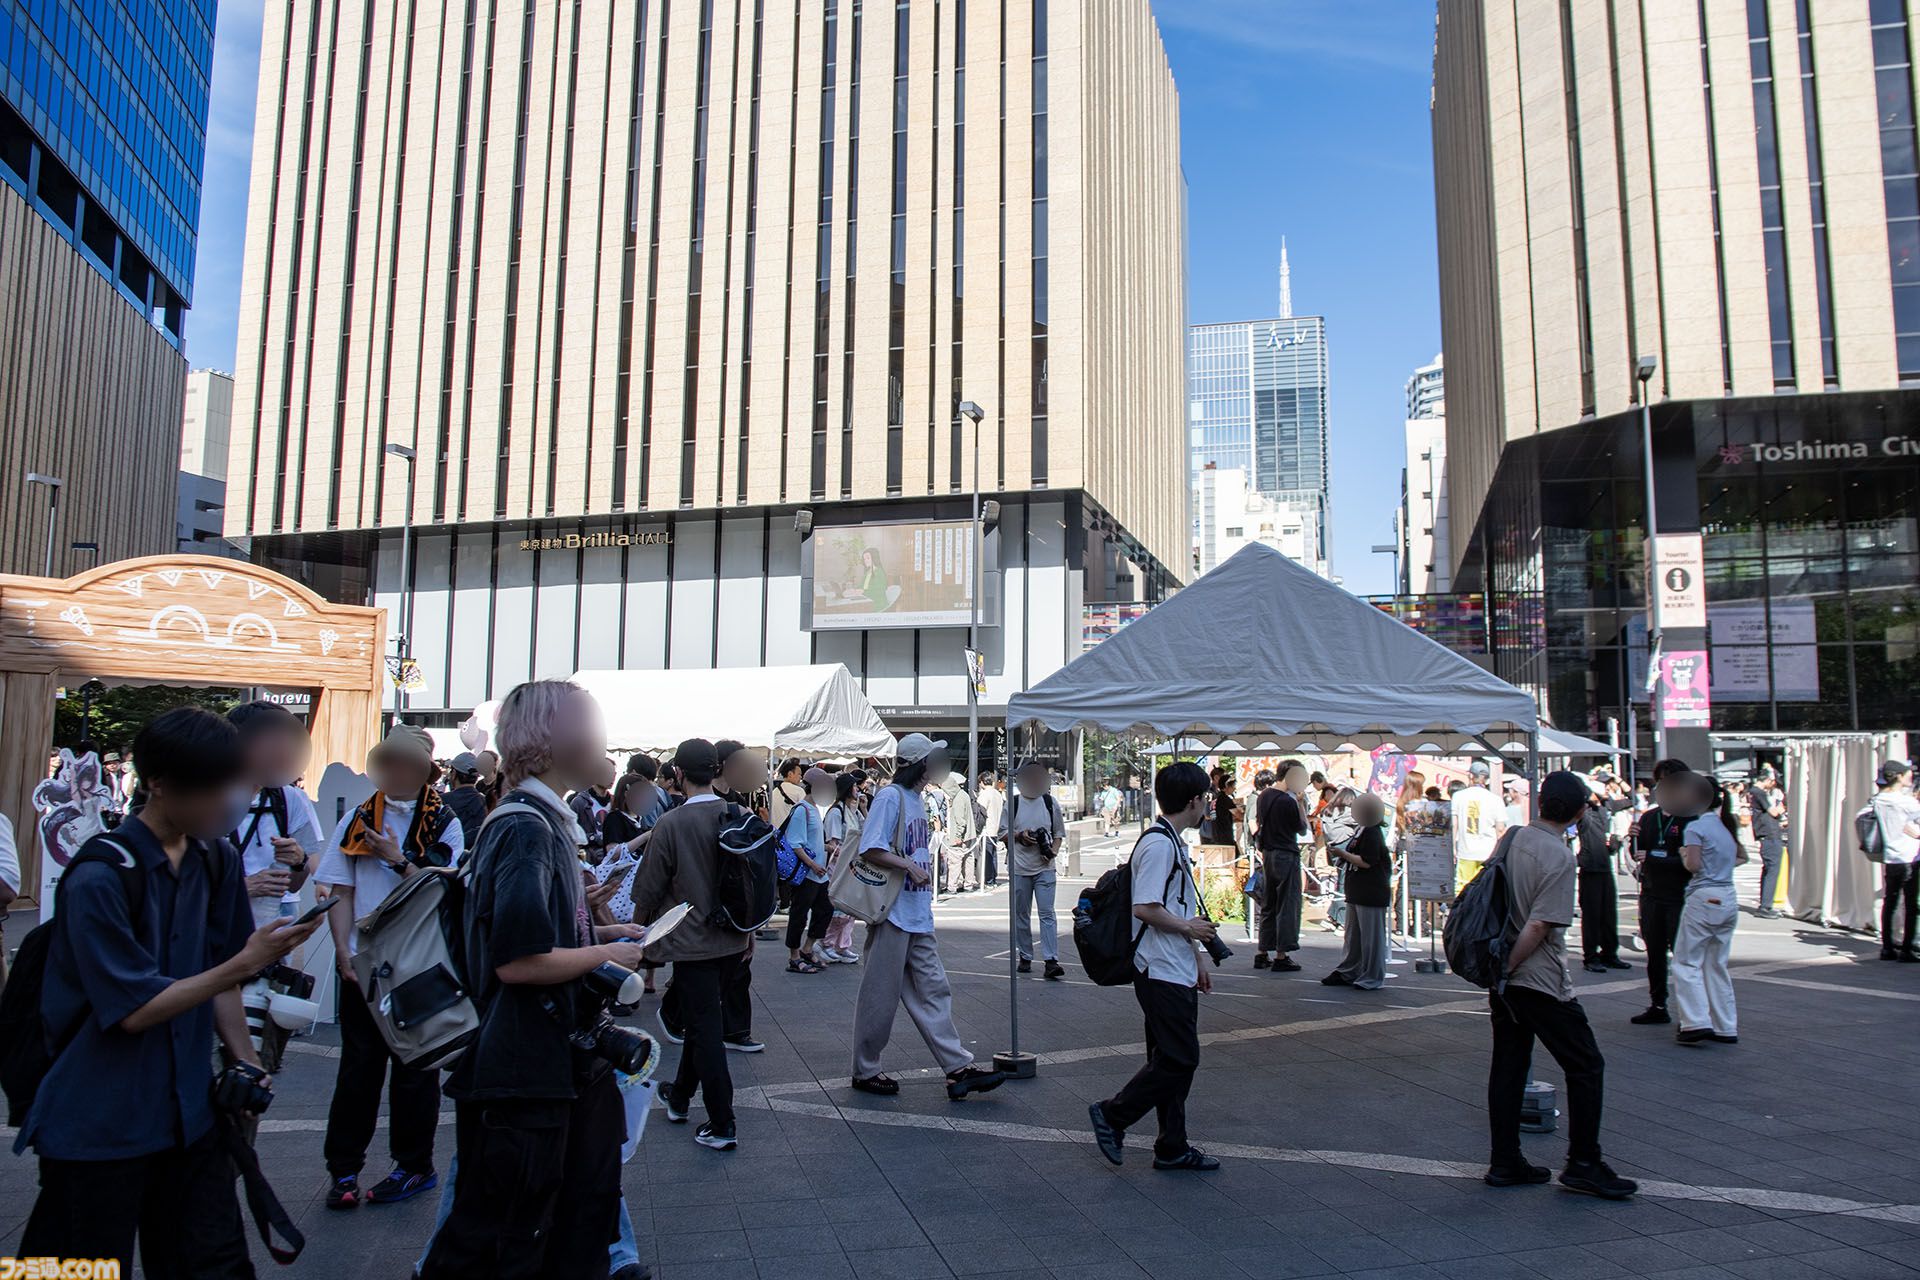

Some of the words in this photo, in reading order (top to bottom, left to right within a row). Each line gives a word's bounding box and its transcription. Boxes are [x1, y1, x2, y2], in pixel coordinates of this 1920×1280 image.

[1750, 440, 1868, 462] Toshima
[519, 538, 562, 550] 東京建物
[565, 532, 630, 549] Brillia
[634, 532, 674, 545] HALL
